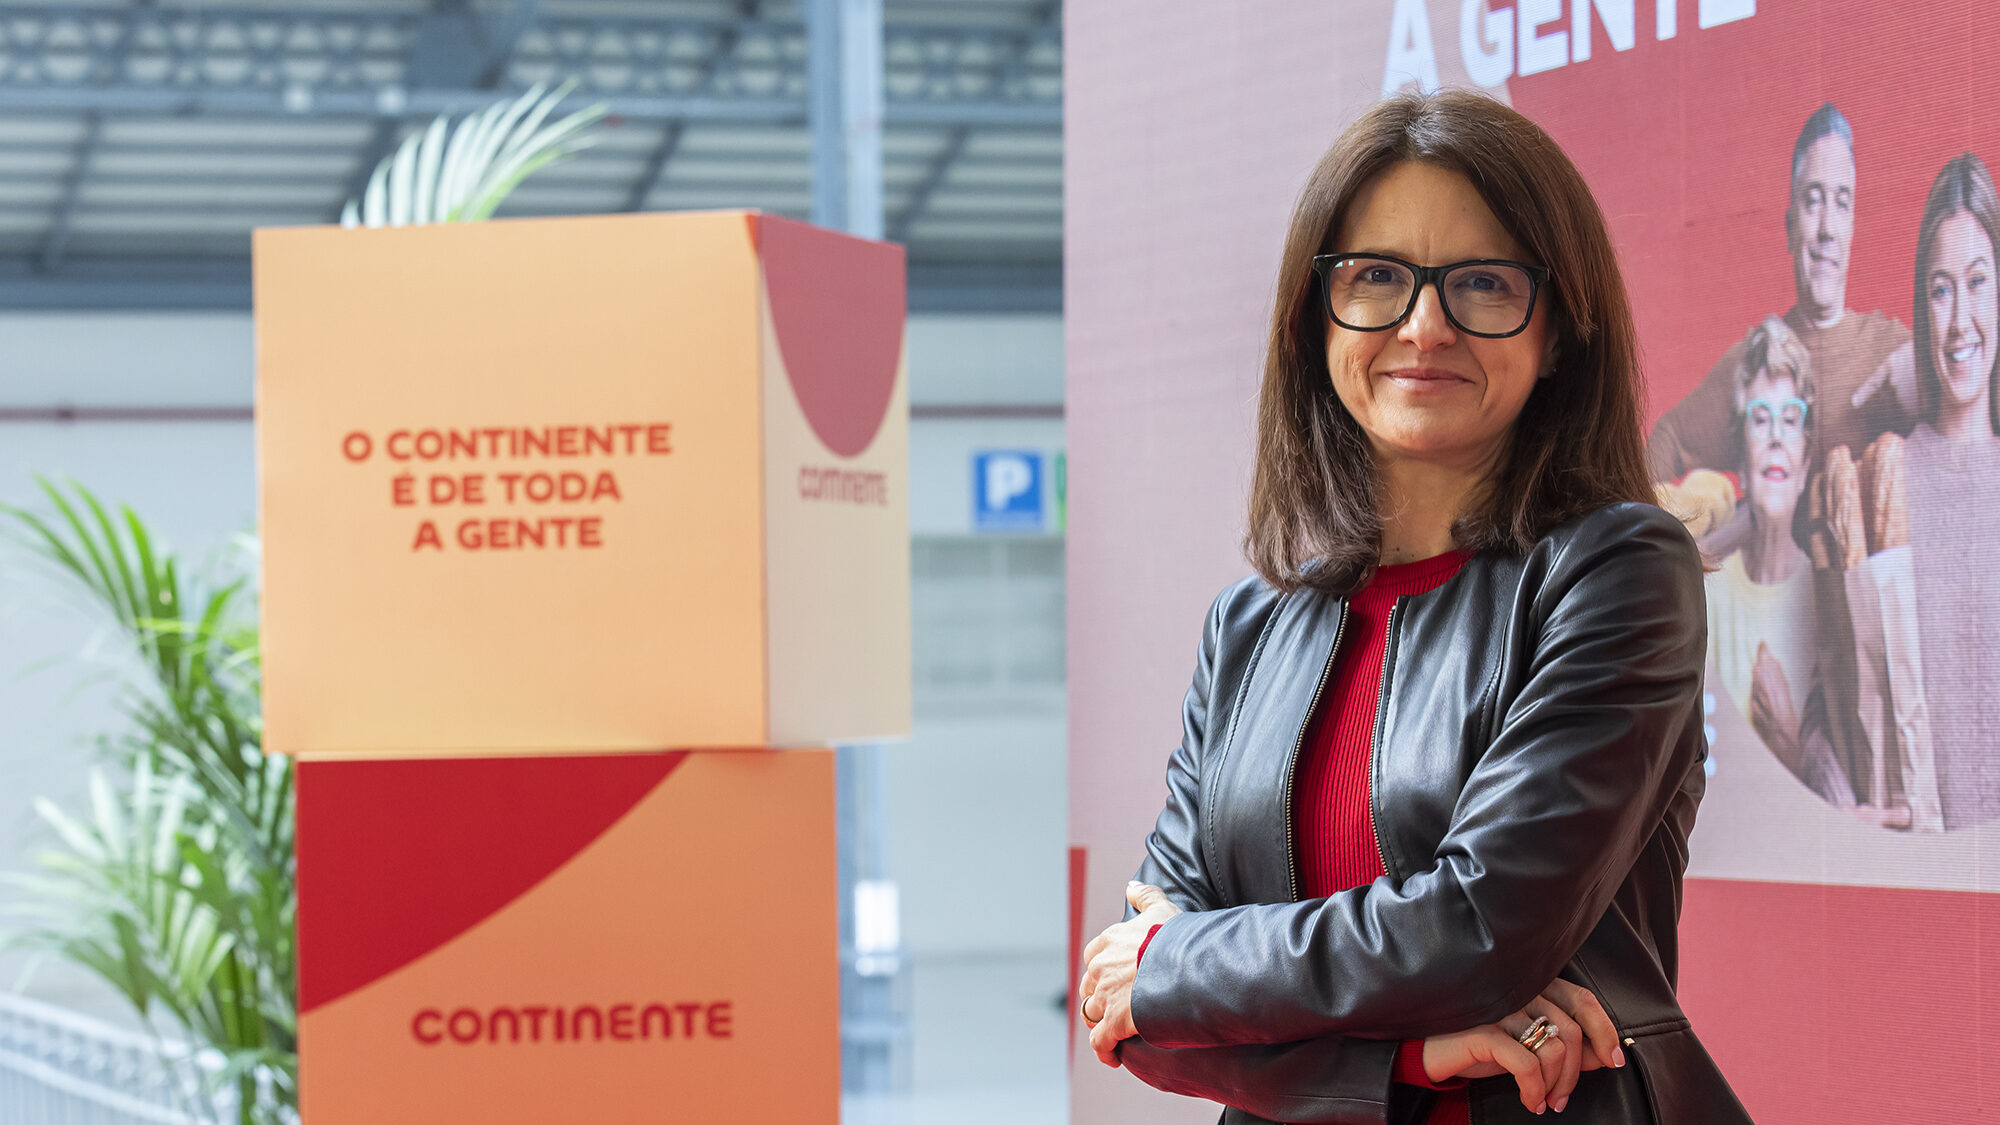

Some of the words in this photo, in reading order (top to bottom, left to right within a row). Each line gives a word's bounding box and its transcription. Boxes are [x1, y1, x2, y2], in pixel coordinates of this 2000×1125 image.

[1381, 0, 1441, 100] A
[342, 430, 372, 463] O
[386, 422, 672, 462] CONTINENTE
[392, 470, 416, 506] É
[428, 474, 485, 506] DE
[497, 470, 622, 505] TODA
[984, 456, 1033, 511] P
[412, 518, 443, 552] A
[456, 515, 604, 550] GENTE
[410, 999, 733, 1045] CONTINENTE
